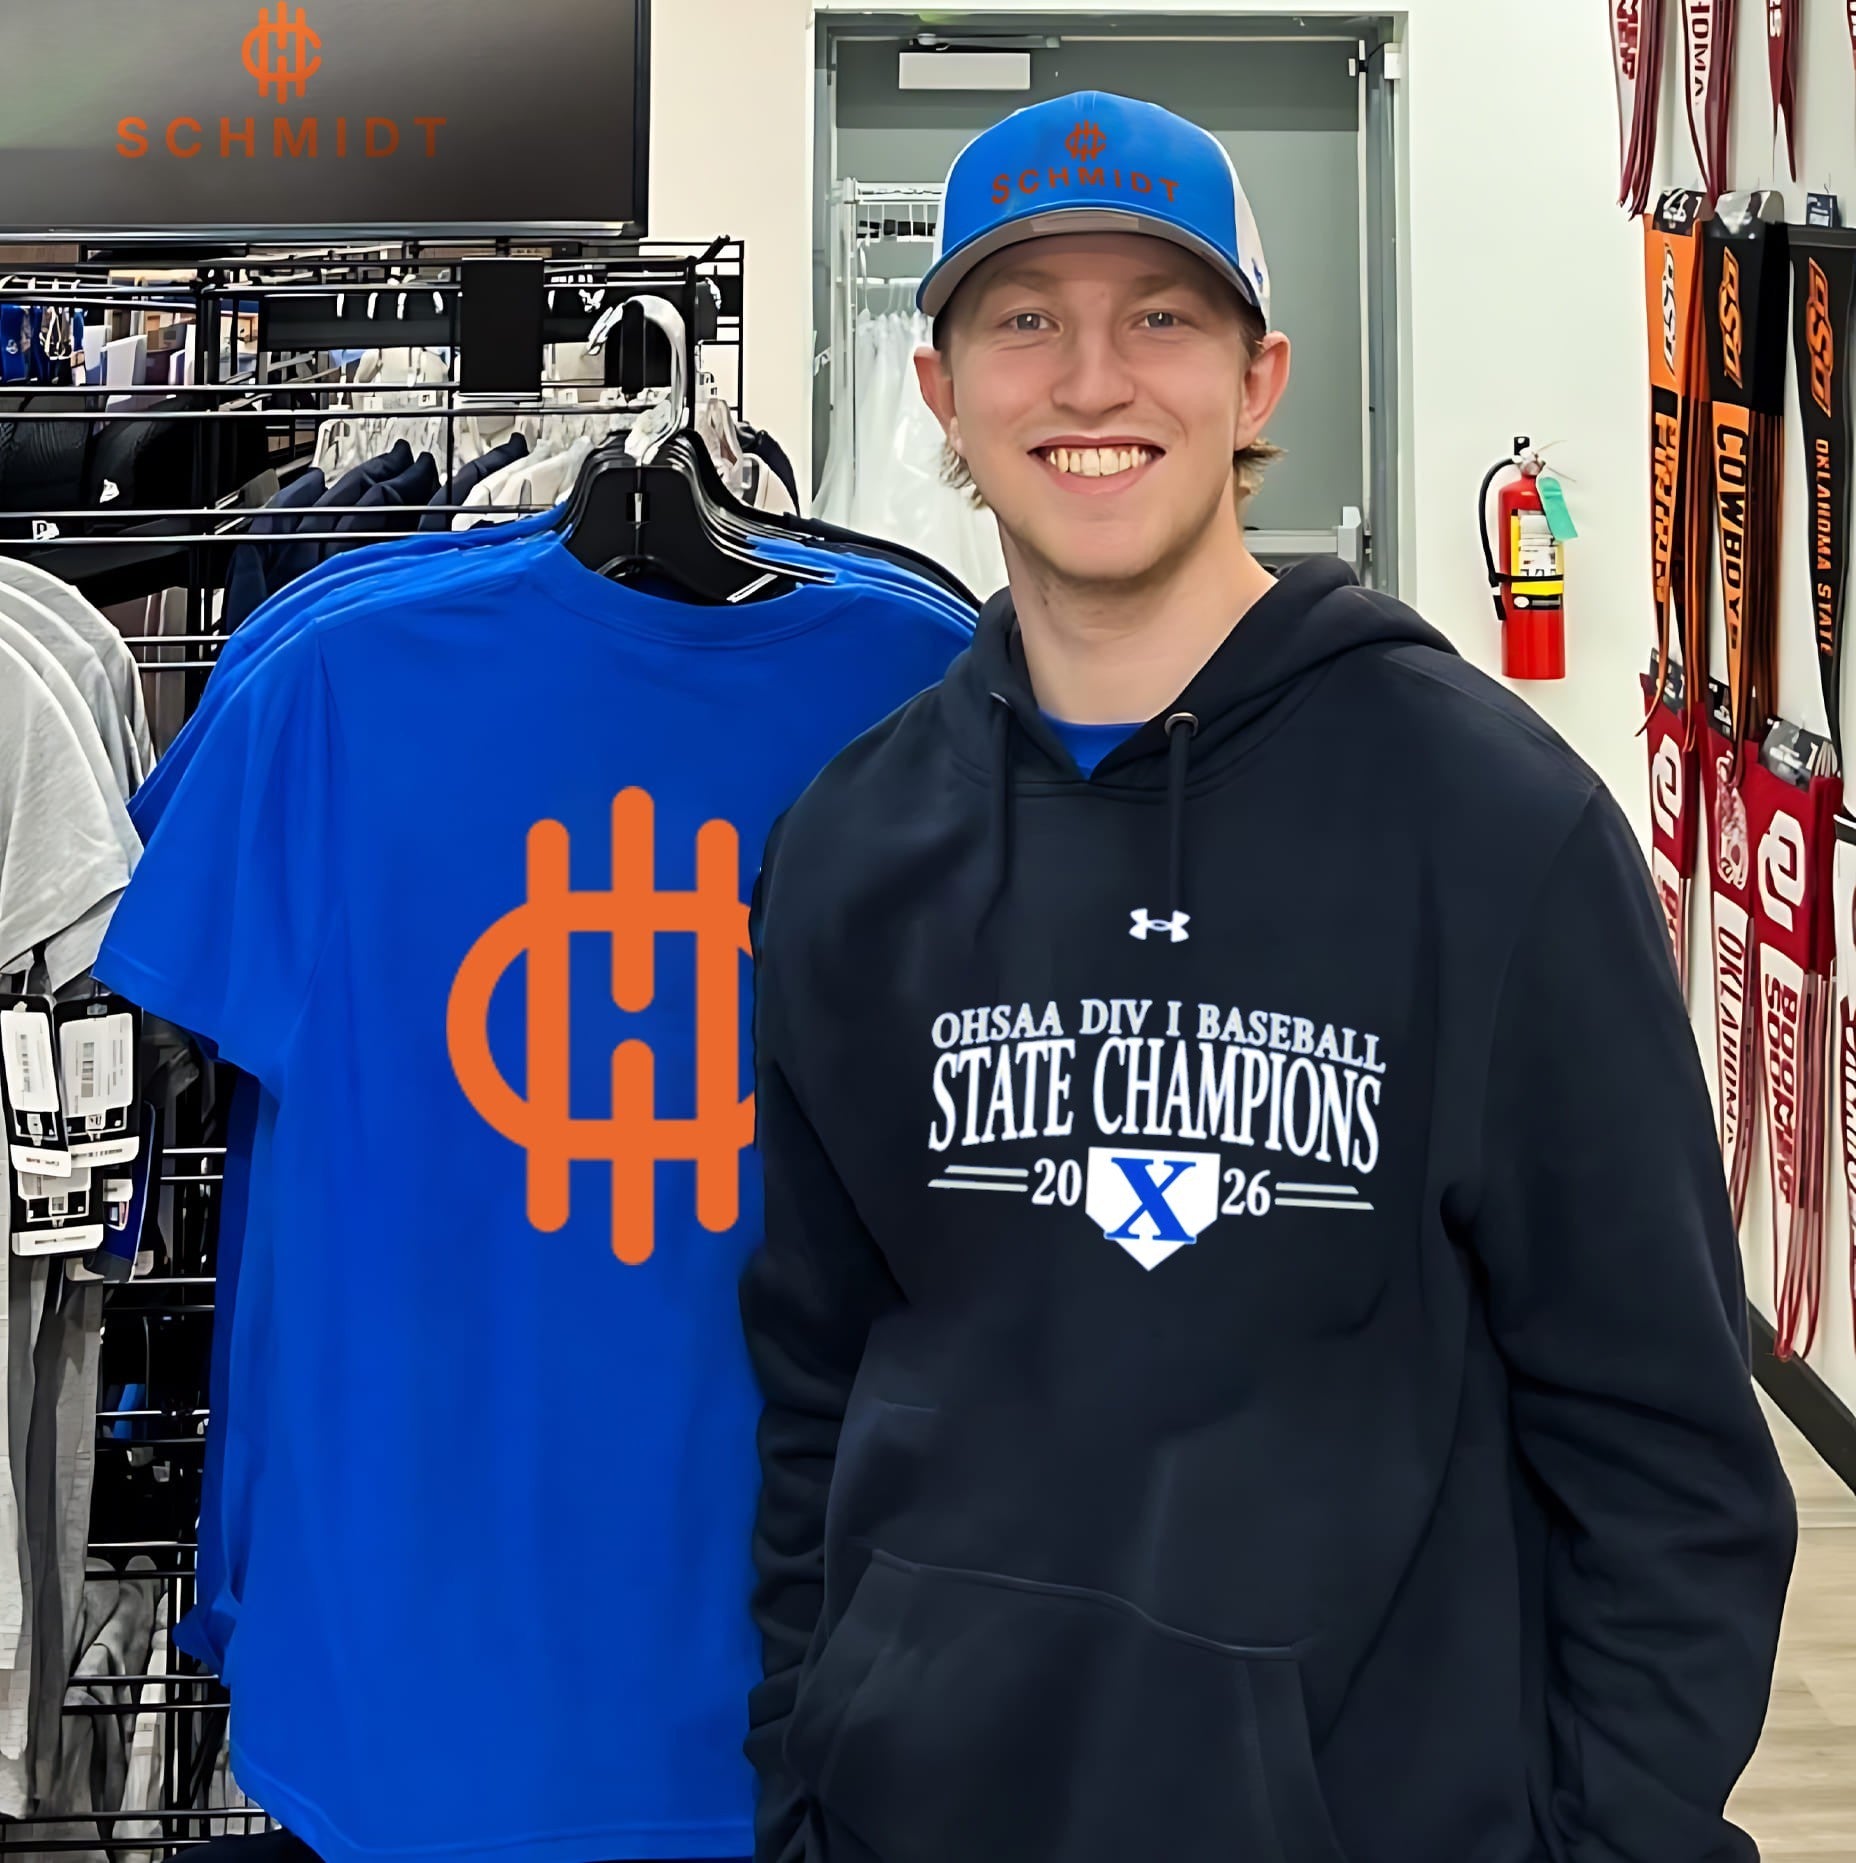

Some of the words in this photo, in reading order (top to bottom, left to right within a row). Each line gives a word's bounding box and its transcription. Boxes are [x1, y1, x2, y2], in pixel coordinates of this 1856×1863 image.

[116, 116, 447, 159] SCHMIDT
[991, 167, 1179, 205] SCHMIDT
[931, 1000, 1064, 1049] OHSAA
[1078, 998, 1153, 1036] DIV
[1165, 1000, 1183, 1037] I
[1196, 1002, 1387, 1073] BASEBALL
[927, 1037, 1076, 1151] STATE
[1092, 1036, 1382, 1174] CHAMPIONS
[1031, 1157, 1083, 1206] 20
[1104, 1156, 1198, 1245] X
[1221, 1168, 1271, 1217] 26
